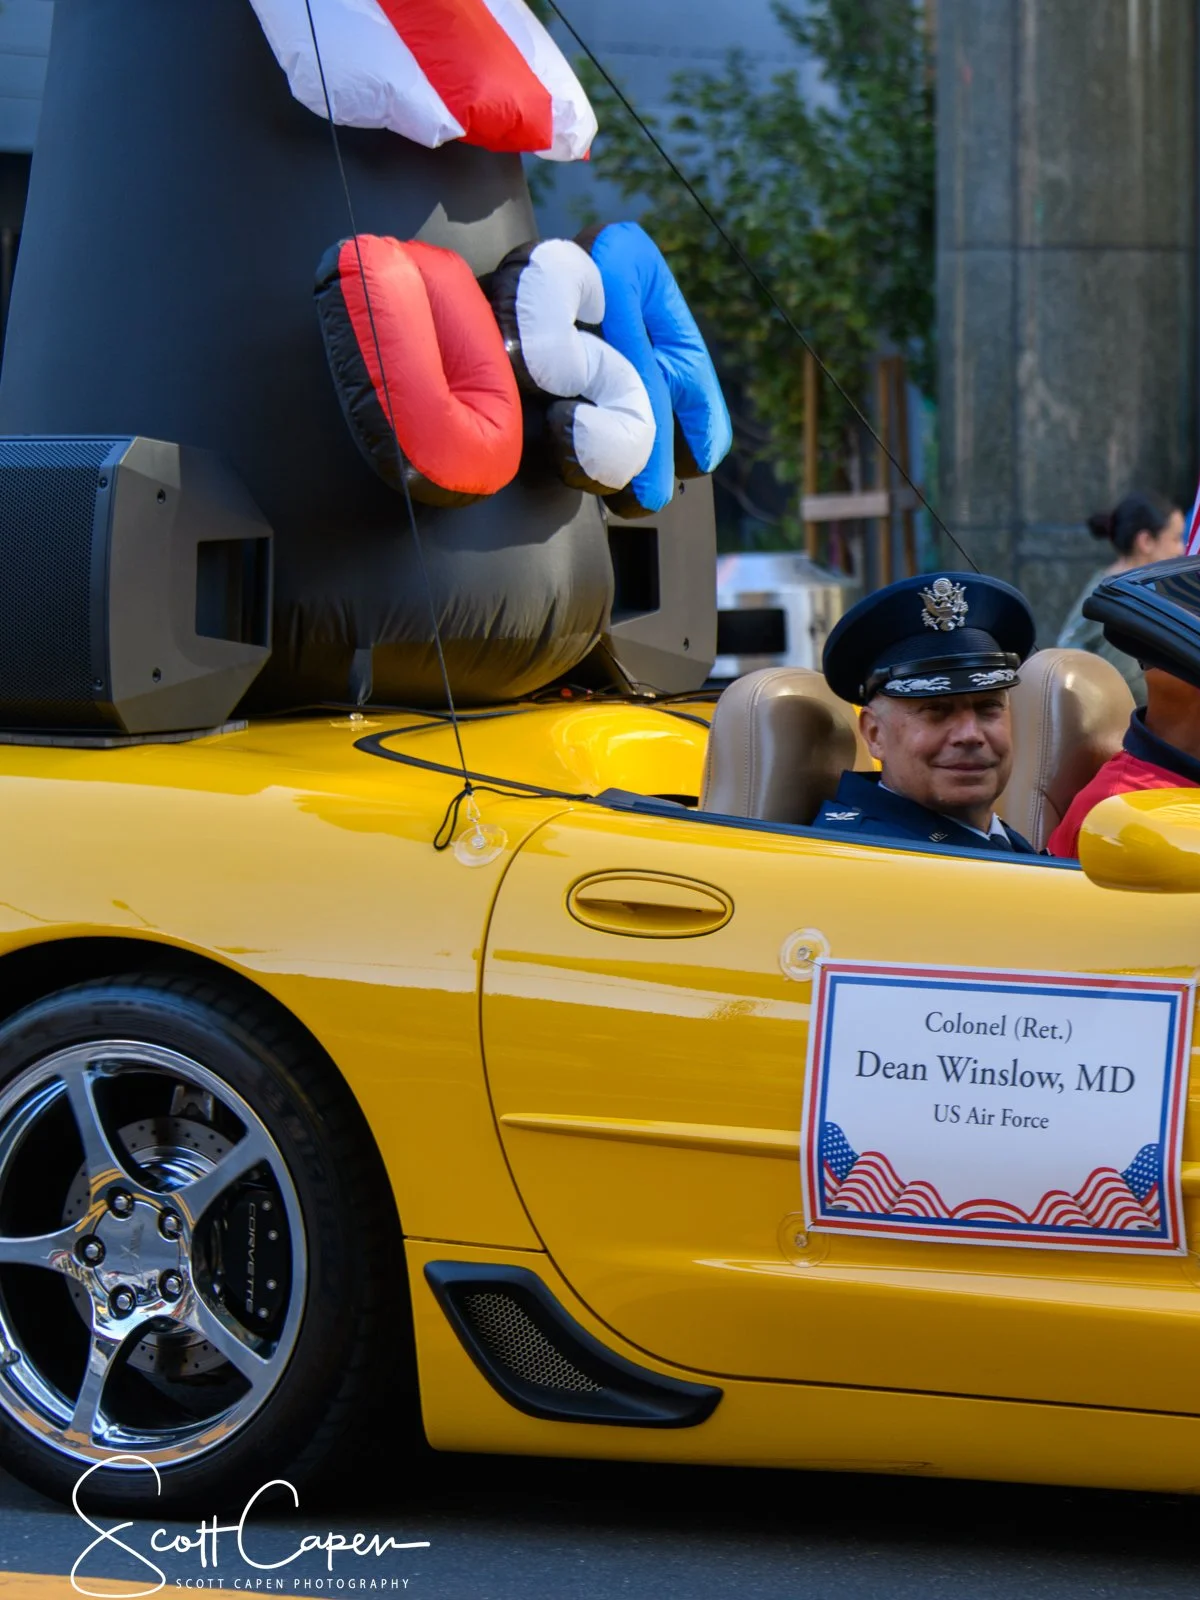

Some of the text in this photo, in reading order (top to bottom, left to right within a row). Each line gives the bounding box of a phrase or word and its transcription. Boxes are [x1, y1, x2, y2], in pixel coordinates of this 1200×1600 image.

[318, 222, 733, 515] USA
[925, 1011, 1073, 1043] Colonel (Ret.)
[855, 1050, 1136, 1094] Dean Winslow, MD
[933, 1104, 1050, 1130] US Air Force
[246, 1202, 257, 1314] CORVETTE
